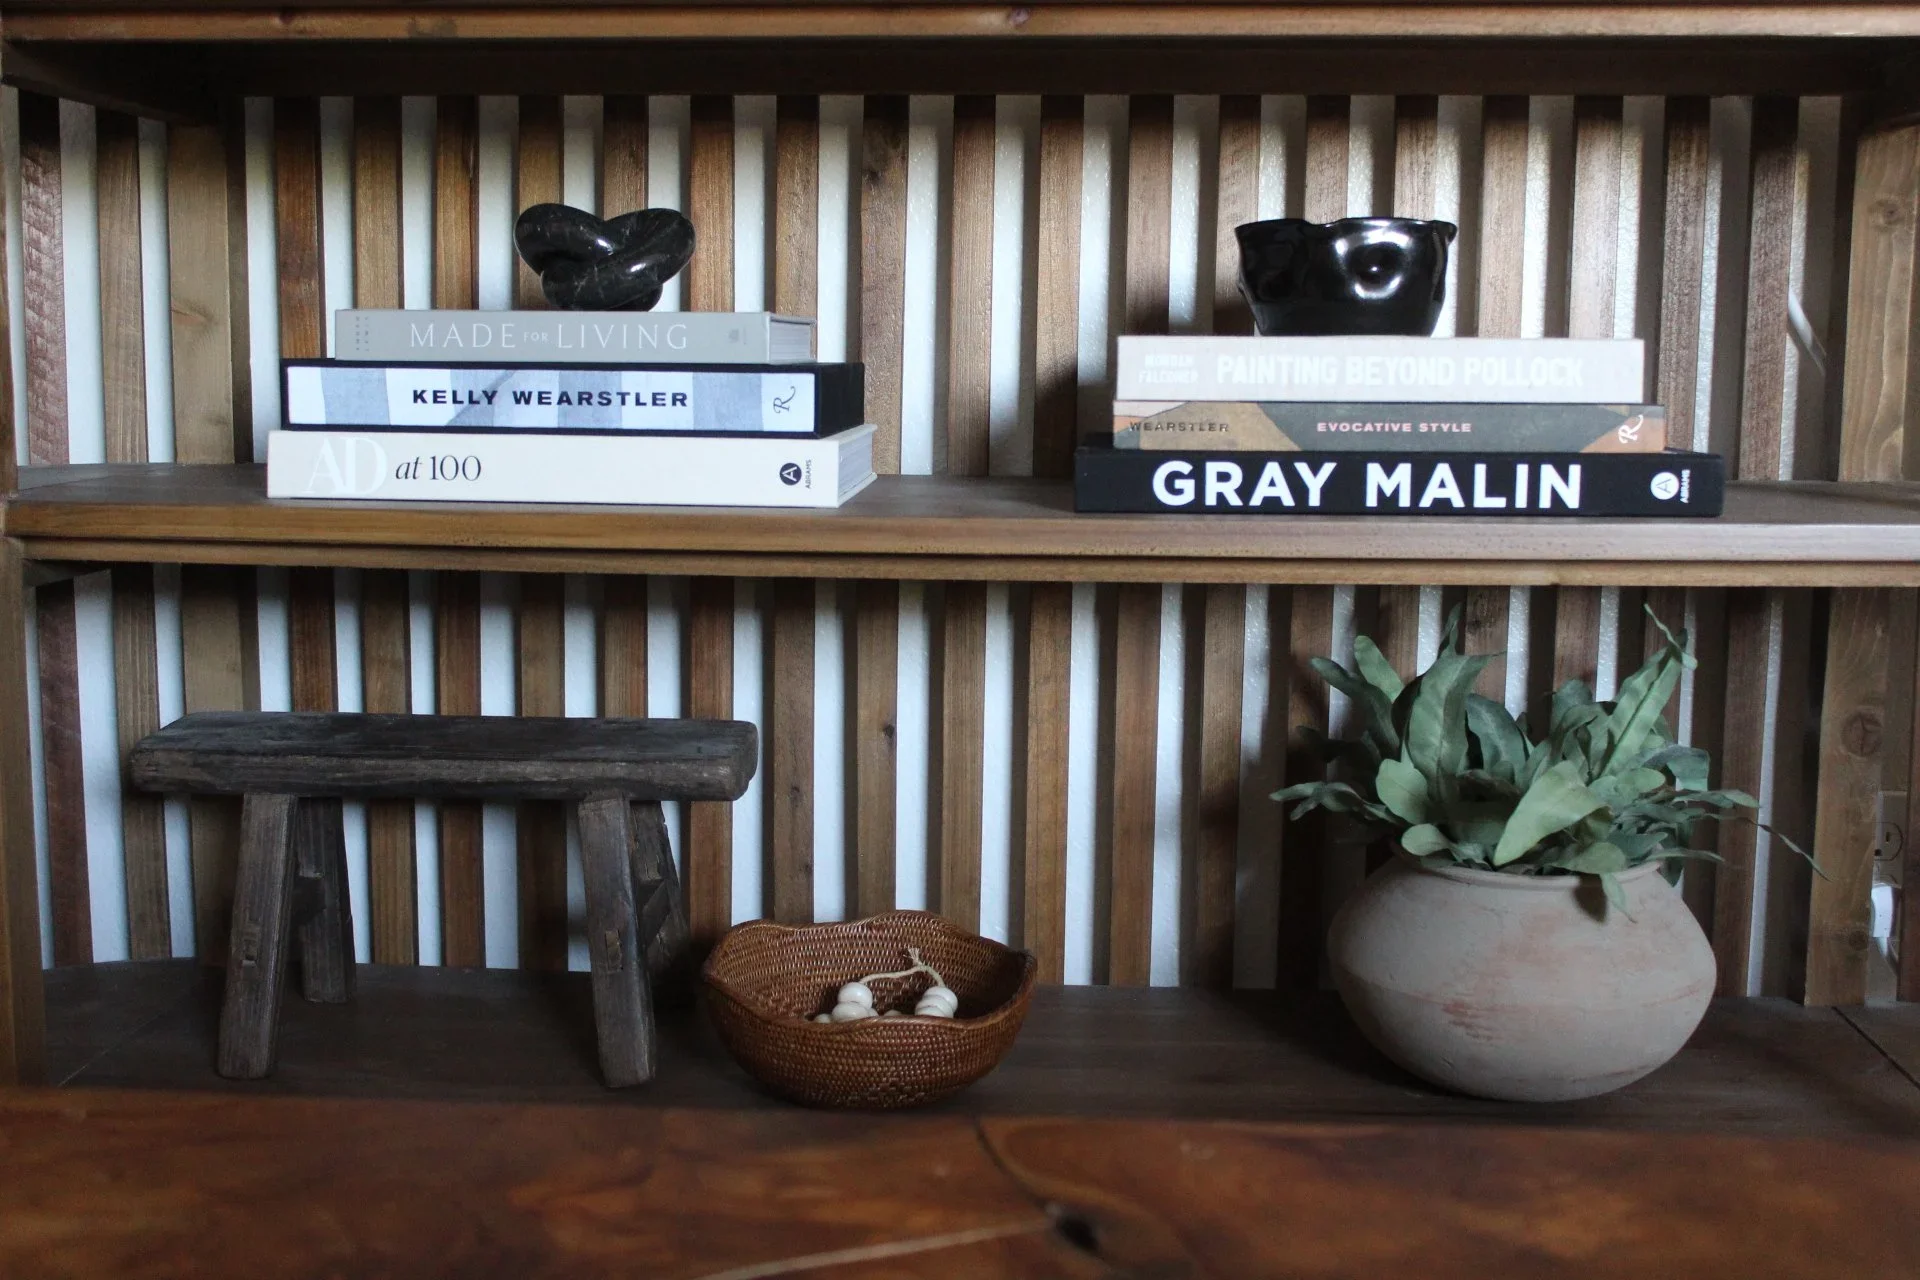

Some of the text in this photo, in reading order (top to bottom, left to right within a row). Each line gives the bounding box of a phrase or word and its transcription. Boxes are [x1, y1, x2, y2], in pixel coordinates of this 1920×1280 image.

[409, 323, 688, 350] MADE FOR LIVING
[1217, 355, 1339, 386] PAINTING
[1345, 355, 1455, 387] BEYOND
[1464, 356, 1584, 387] POLLOCK
[412, 389, 688, 407] KELLY WEARSTLER
[1129, 421, 1230, 432] WEARSTLER
[1316, 422, 1472, 433] EVOCATIVE STYLE
[301, 437, 482, 494] AD at 100
[781, 464, 799, 483] A
[1151, 460, 1582, 509] GRAY MALIN
